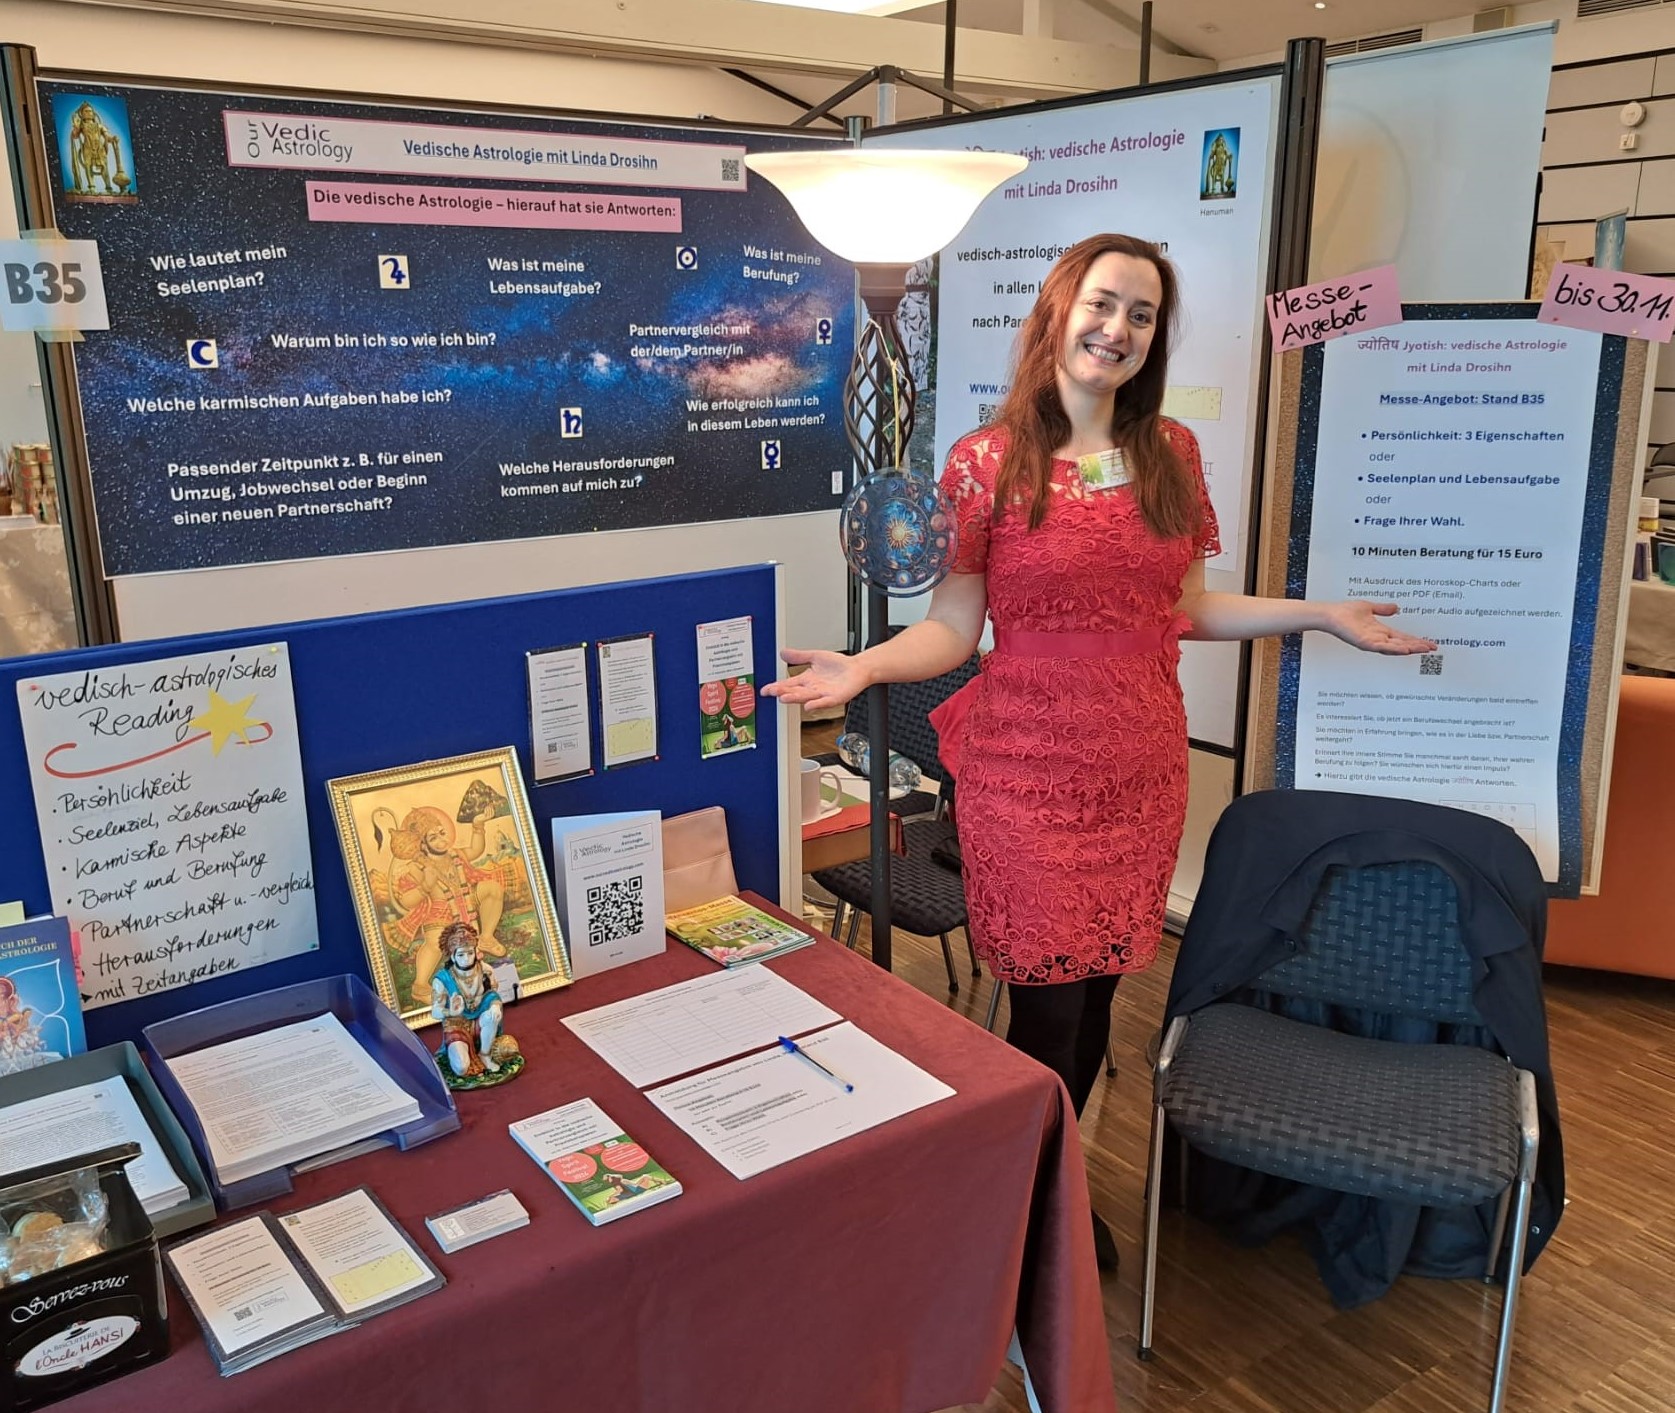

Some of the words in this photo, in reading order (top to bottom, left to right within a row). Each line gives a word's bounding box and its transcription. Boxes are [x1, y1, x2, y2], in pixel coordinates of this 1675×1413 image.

[262, 121, 331, 143] Vedic
[272, 139, 353, 163] Astrology
[403, 140, 469, 158] Vedische
[473, 144, 543, 165] Astrologie
[546, 150, 568, 164] mit
[572, 150, 607, 167] Linda
[610, 153, 658, 170] Drosihn
[1049, 142, 1106, 160] vedische
[1110, 130, 1185, 153] Astrologie
[1004, 186, 1025, 199] mit
[1028, 181, 1062, 197] Linda
[1066, 176, 1118, 194] Drosihn
[313, 189, 342, 204] Die
[345, 190, 415, 207] vedische
[419, 194, 492, 212] Astrologie
[506, 197, 556, 213] hierauf
[559, 200, 581, 213] hat
[584, 201, 604, 215] sie
[607, 203, 676, 217] Antworten:
[150, 254, 186, 272] Wie
[189, 249, 242, 268] lautet
[245, 245, 287, 262] mein
[743, 245, 763, 259] Was
[765, 248, 784, 261] ist
[786, 252, 821, 266] meine
[957, 243, 1074, 261] vedisch-astrologisc
[487, 258, 518, 272] Was
[521, 257, 539, 271] ist
[541, 259, 585, 272] meine
[742, 266, 800, 286] Berufung?
[5, 262, 86, 305] B35
[157, 271, 265, 298] Seelenplan?
[489, 280, 602, 297] Lebensaufgabe?
[993, 282, 1004, 294] in
[1006, 281, 1035, 294] allen
[1555, 274, 1592, 306] bis
[1270, 283, 1372, 319] Messe-
[629, 324, 725, 339] Partnervergleich
[727, 323, 751, 335] mit
[973, 316, 1001, 328] nach
[1281, 301, 1367, 345] Angebot
[271, 334, 331, 349] Warum
[335, 334, 360, 348] bin
[363, 334, 387, 348] ich
[390, 337, 409, 347] so
[412, 334, 437, 347] wie
[440, 333, 463, 346] ich
[466, 332, 497, 346] bin?
[630, 344, 683, 358] der/dem
[684, 343, 743, 357] Partner/in
[1403, 340, 1447, 353] Jyotish:
[1451, 340, 1501, 351] vedische
[1505, 339, 1567, 352] Astrologie
[1407, 362, 1427, 372] mit
[1430, 362, 1462, 373] Linda
[1466, 362, 1512, 373] Drosihn
[127, 397, 196, 413] Welche
[200, 394, 300, 411] karmischen
[303, 391, 378, 409] Aufgaben
[381, 390, 419, 404] habe
[421, 389, 452, 403] ich?
[686, 399, 709, 412] Wie
[711, 396, 773, 412] erfolgreich
[775, 396, 800, 409] kann
[802, 395, 820, 408] ich
[1380, 394, 1479, 405] Messe-Angebot:
[1482, 394, 1518, 404] Stand
[1521, 394, 1545, 404] B35
[687, 420, 697, 432] in
[700, 417, 741, 431] diesem
[744, 416, 778, 429] Leben
[781, 413, 826, 427] werden?
[1371, 431, 1462, 441] Persönlichkeit:
[1465, 431, 1473, 441] 3
[1475, 431, 1565, 443] Eigenschaften
[167, 460, 257, 478] Passender
[261, 456, 339, 475] Zeitpunkt
[343, 458, 356, 468] z.
[359, 454, 374, 467] B.
[377, 452, 400, 466] für
[402, 451, 443, 465] einen
[499, 462, 550, 477] Welche
[553, 454, 675, 474] Herausforderungen
[1369, 452, 1395, 462] oder
[170, 484, 236, 503] Umzug,
[240, 478, 334, 497] Jobwechsel
[338, 477, 374, 492] oder
[377, 474, 428, 491] Beginn
[500, 482, 559, 498] kommen
[562, 479, 583, 494] auf
[586, 477, 617, 492] mich
[620, 475, 643, 489] zu?
[1367, 474, 1436, 485] Seelenplan
[1439, 474, 1462, 484] und
[1465, 474, 1560, 487] Lebensaufgabe
[173, 510, 218, 525] einer
[222, 507, 273, 521] neuen
[277, 497, 393, 517] Partnerschaft?
[1365, 495, 1391, 504] oder
[1364, 516, 1396, 528] Frage
[1399, 516, 1427, 526] Ihrer
[1430, 516, 1464, 527] Wahl.
[1352, 547, 1365, 556] 10
[1368, 547, 1417, 557] Minuten
[1420, 548, 1474, 560] Beratung
[1477, 548, 1495, 558] für
[1498, 549, 1511, 558] 15
[1515, 549, 1543, 559] Euro
[1347, 589, 1395, 600] Zusendung
[1396, 591, 1411, 600] per
[1413, 590, 1431, 599] PDF
[1432, 590, 1465, 600] (Email).
[1348, 577, 1362, 586] Mit
[1364, 577, 1404, 586] Ausdruck
[1406, 578, 1422, 586] des
[1424, 578, 1498, 589] Horoskop-Charts
[1501, 580, 1522, 588] oder
[1402, 606, 1420, 615] darf
[1421, 608, 1436, 617] per
[1437, 607, 1462, 616] Audio
[1464, 608, 1525, 618] aufgezeichnet
[1528, 609, 1562, 618] werden.
[34, 655, 278, 711] vedisch-astrologisches
[78, 699, 194, 742] Reading
[58, 770, 192, 815] Persönlichkeit
[68, 810, 159, 845] Seelenziel,
[167, 788, 289, 823] Lebensaufgabe
[76, 840, 169, 880] Karmische
[175, 823, 248, 854] Aspekte
[77, 879, 137, 910] Beruf
[143, 869, 182, 891] und
[186, 850, 269, 879] Berufung
[81, 892, 231, 942] Partnerschaft
[234, 894, 247, 907] u.
[0, 941, 14, 950] CH
[17, 937, 37, 946] DER
[0, 942, 57, 959] STROLOGIE
[92, 916, 280, 977] Herausforderungen
[95, 980, 125, 1000] mit
[131, 954, 241, 995] Zeitangaben
[11, 1275, 129, 1323] Servez-vous
[80, 1327, 124, 1354] HANSI
